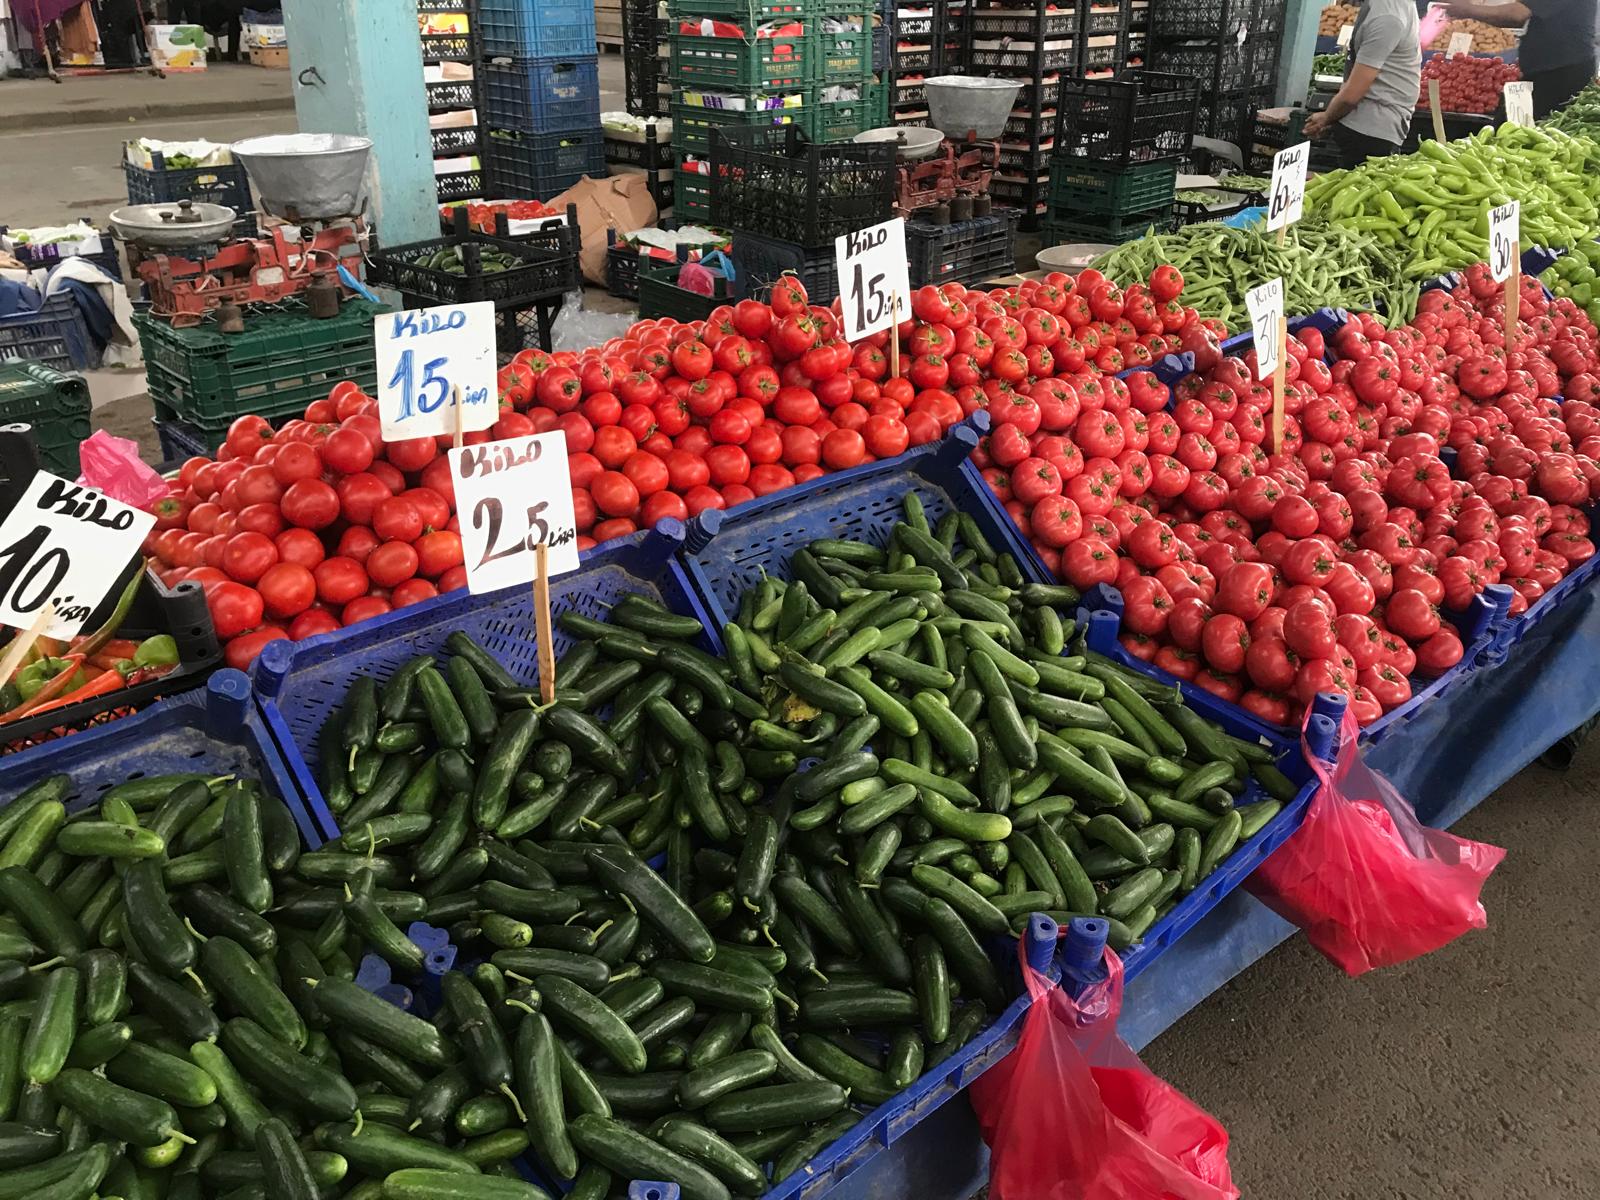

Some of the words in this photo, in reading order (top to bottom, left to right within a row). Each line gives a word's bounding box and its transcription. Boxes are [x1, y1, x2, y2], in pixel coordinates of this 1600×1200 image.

[1494, 232, 1510, 275] 30
[850, 263, 886, 332] 15
[1257, 309, 1276, 365] 30
[387, 349, 451, 423] 15
[0, 525, 70, 613] 10
[472, 497, 549, 573] 25
